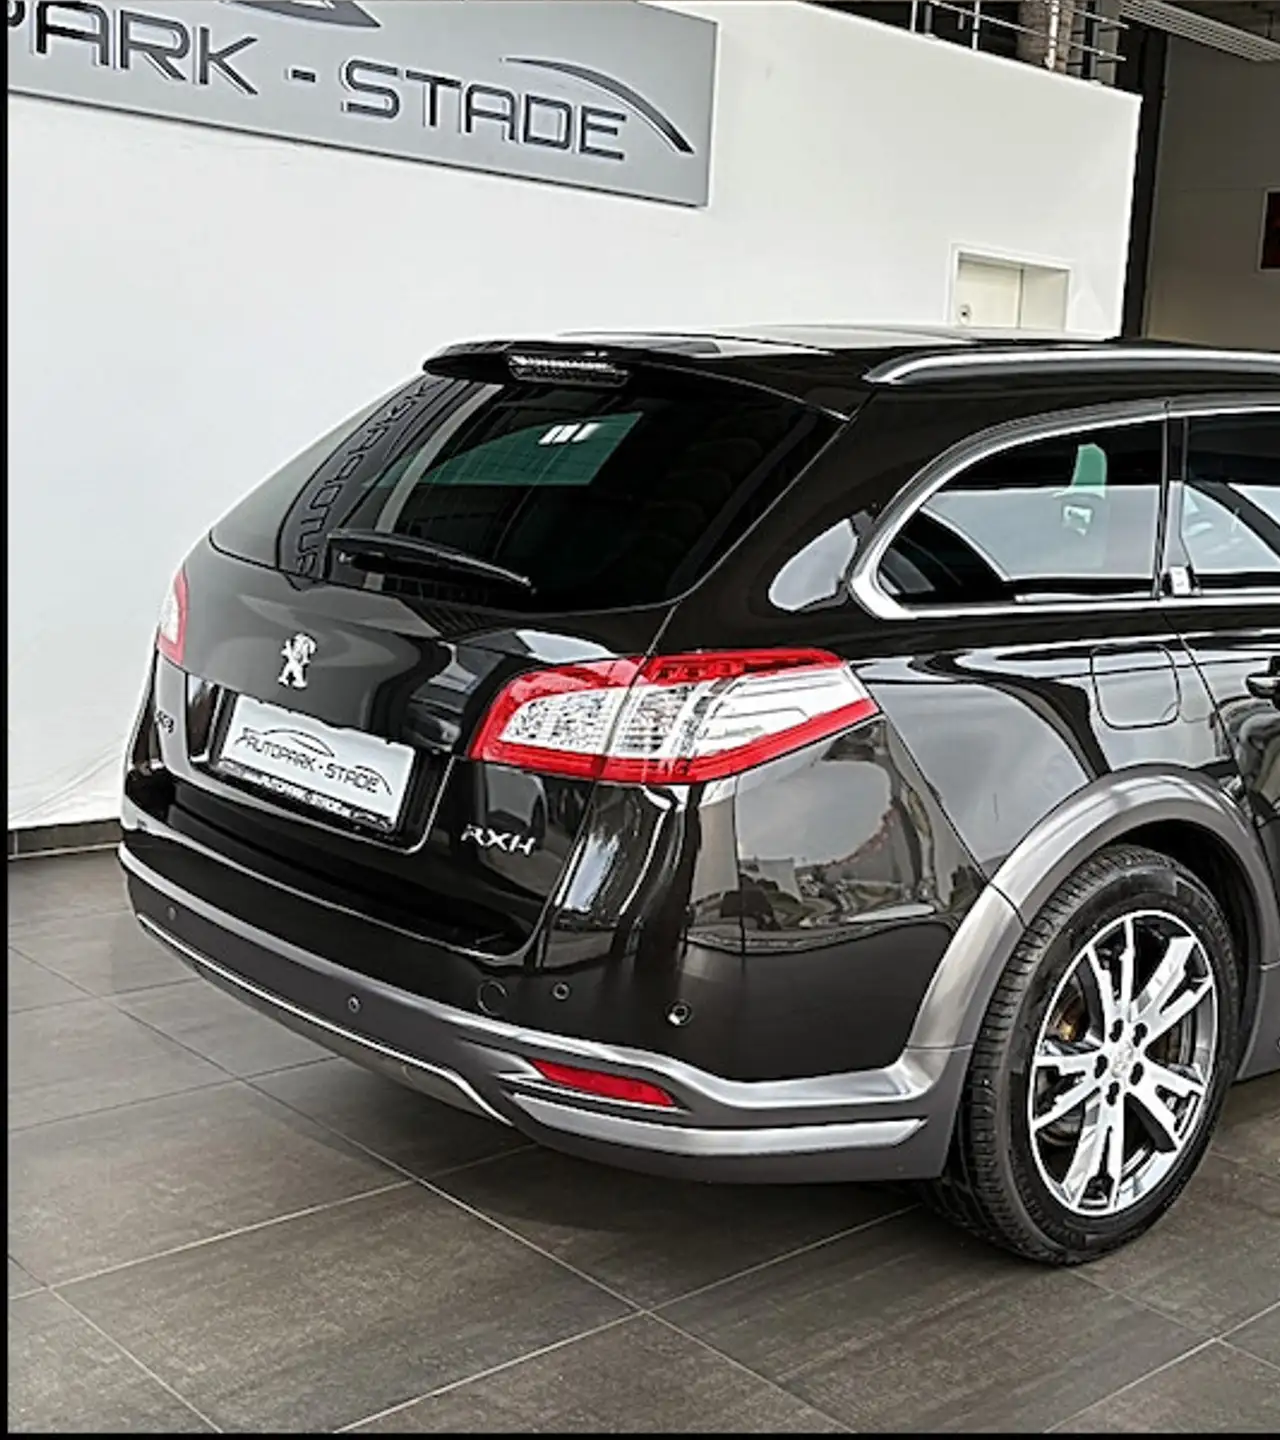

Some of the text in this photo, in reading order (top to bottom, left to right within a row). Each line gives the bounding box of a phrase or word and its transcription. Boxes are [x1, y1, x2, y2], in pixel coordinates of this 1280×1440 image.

[340, 58, 628, 161] STADE
[244, 737, 317, 772] AUTOPARK
[324, 762, 381, 795] STADE
[461, 823, 536, 856] RXH
